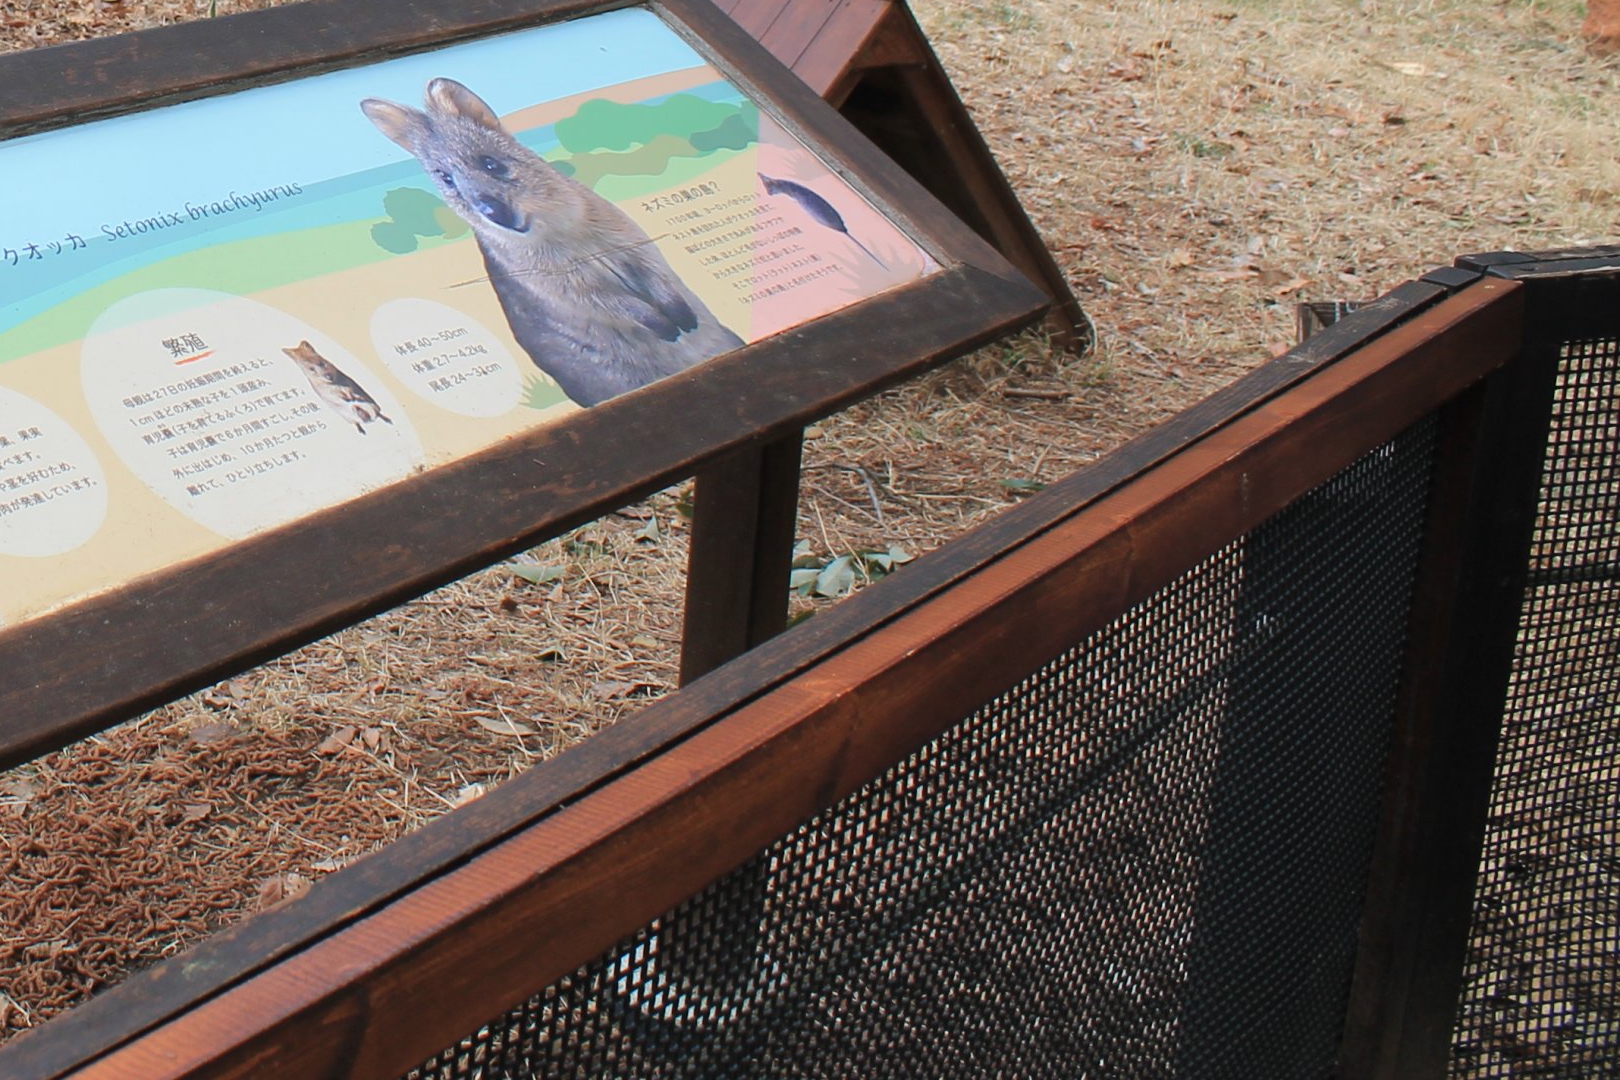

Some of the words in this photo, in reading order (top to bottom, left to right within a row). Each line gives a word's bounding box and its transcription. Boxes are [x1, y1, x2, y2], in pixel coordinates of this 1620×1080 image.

[100, 209, 184, 242] Setonix
[184, 180, 303, 222] brachyurus
[3, 231, 87, 266] クオッカ
[161, 332, 209, 359] 繁殖
